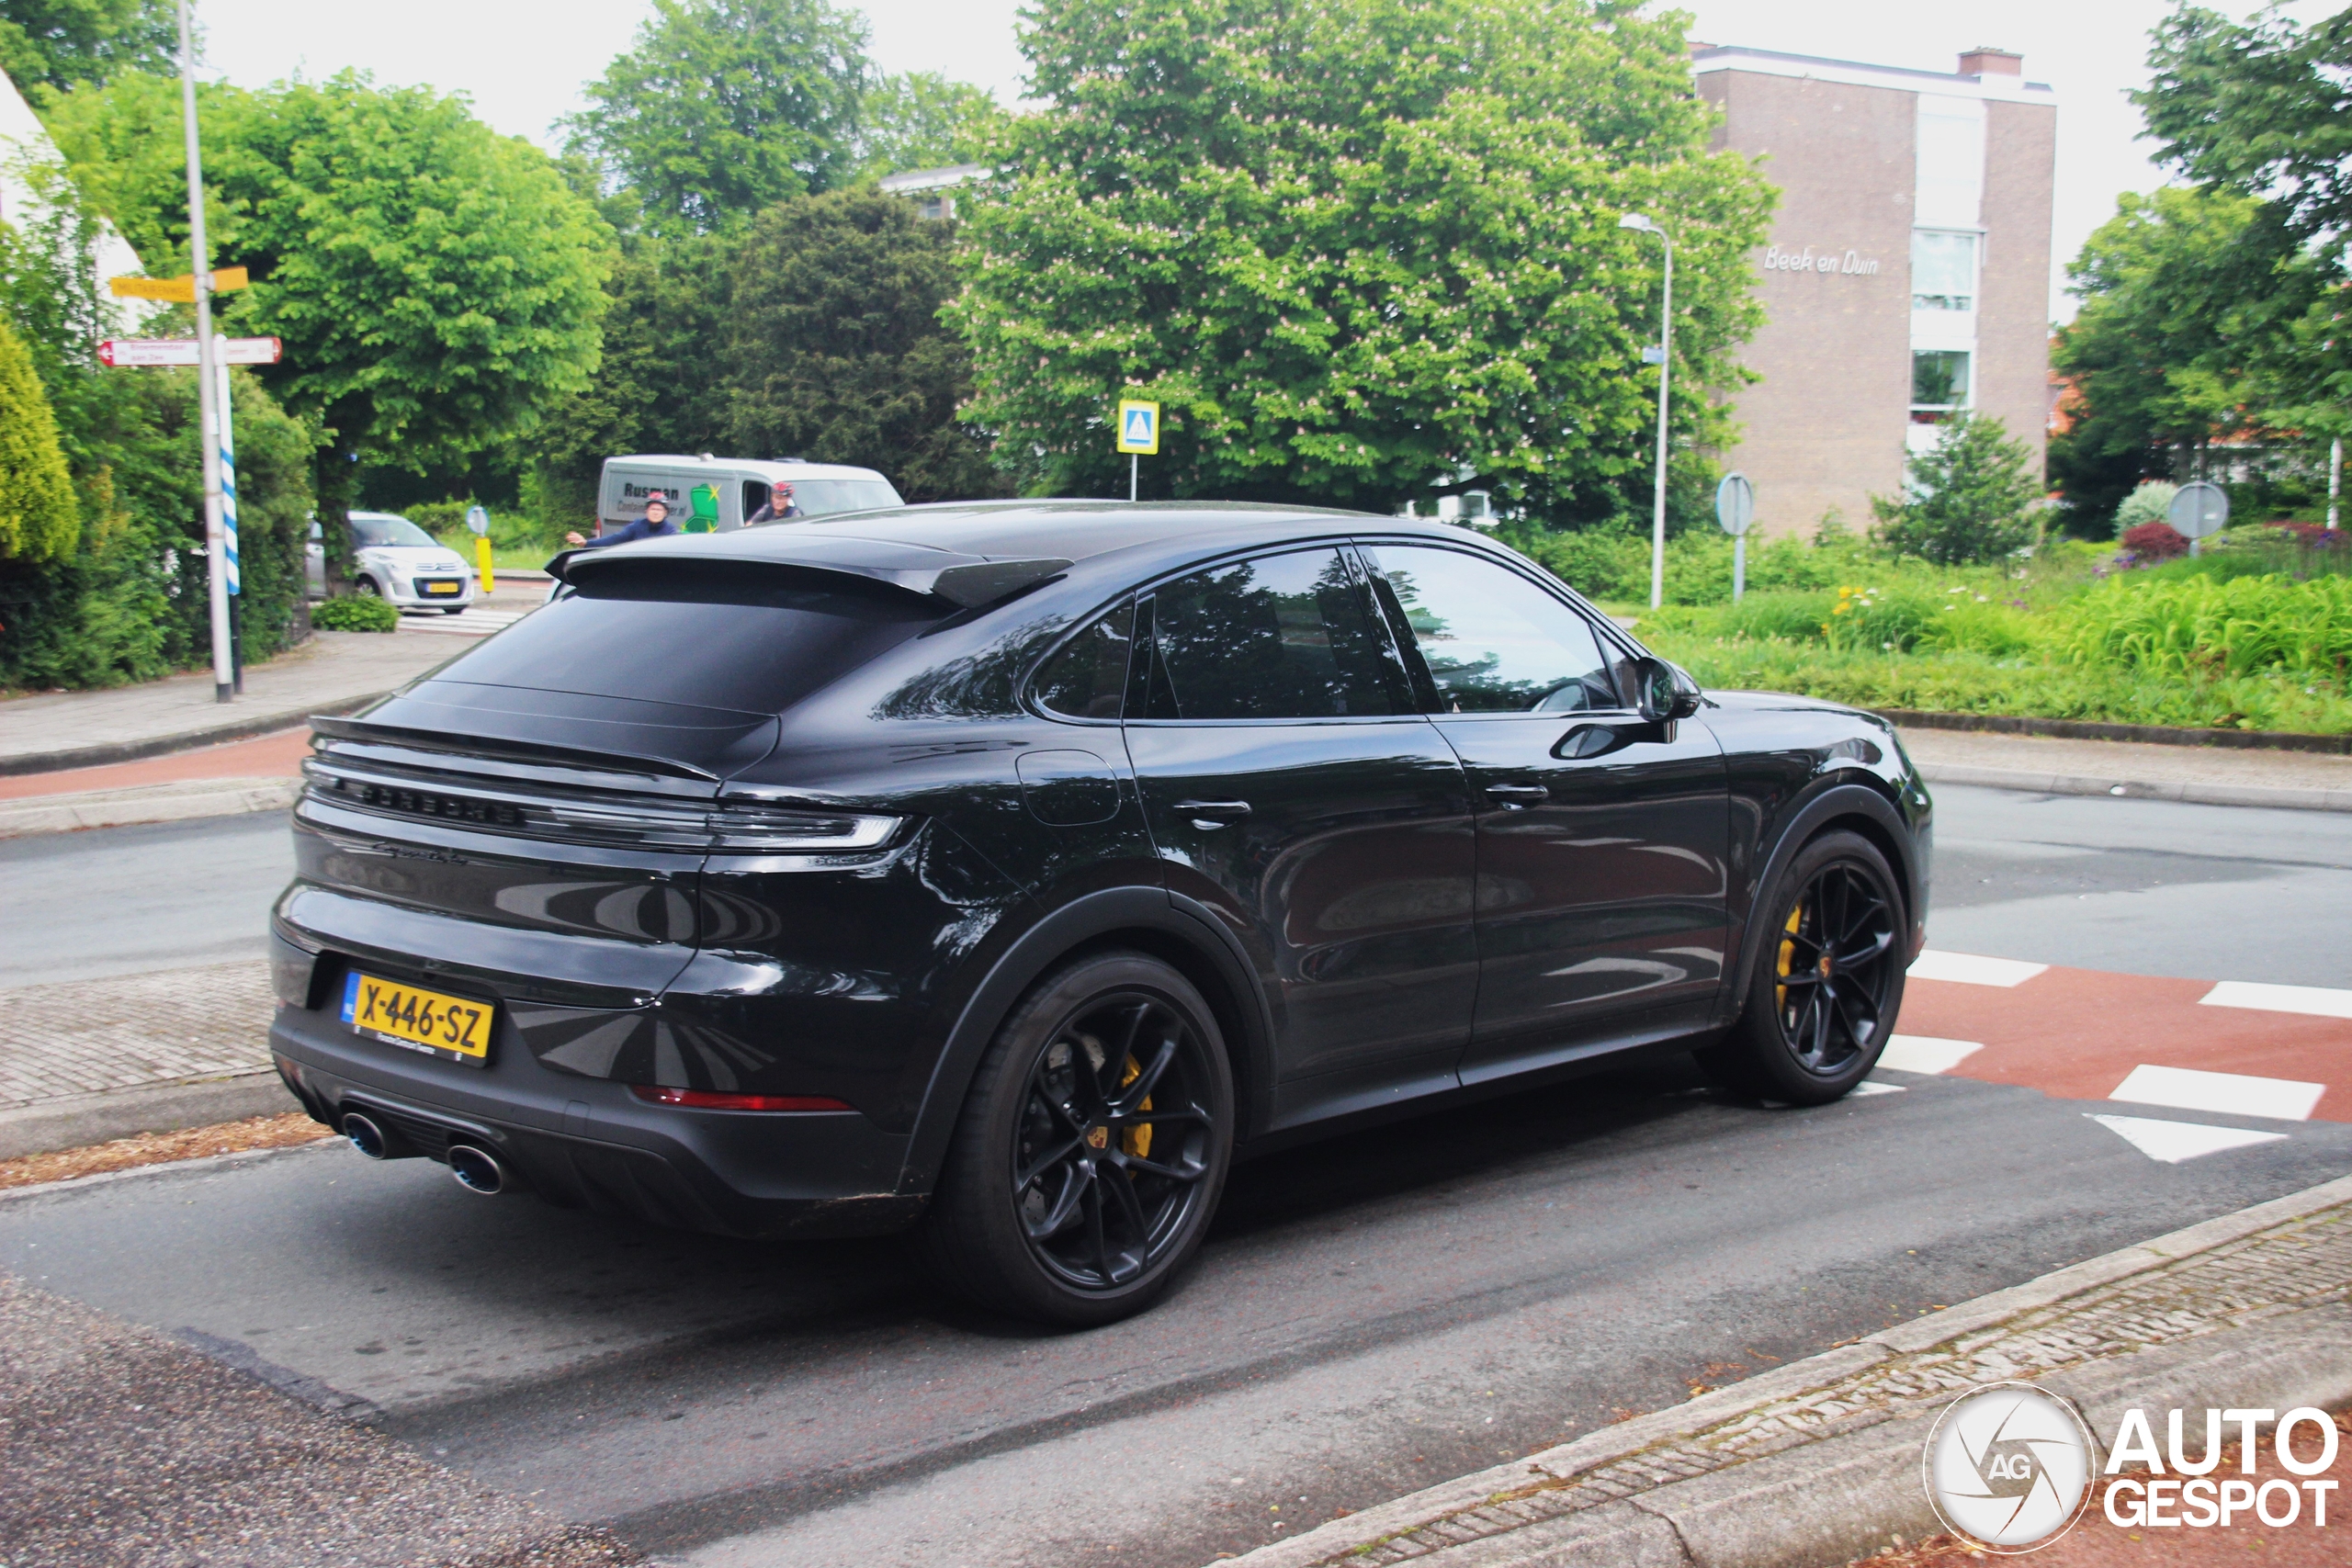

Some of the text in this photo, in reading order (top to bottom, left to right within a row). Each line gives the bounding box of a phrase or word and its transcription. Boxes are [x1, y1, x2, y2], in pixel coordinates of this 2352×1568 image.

[1764, 245, 1878, 275] Beek en Duin
[362, 984, 481, 1049] X-446-SZ
